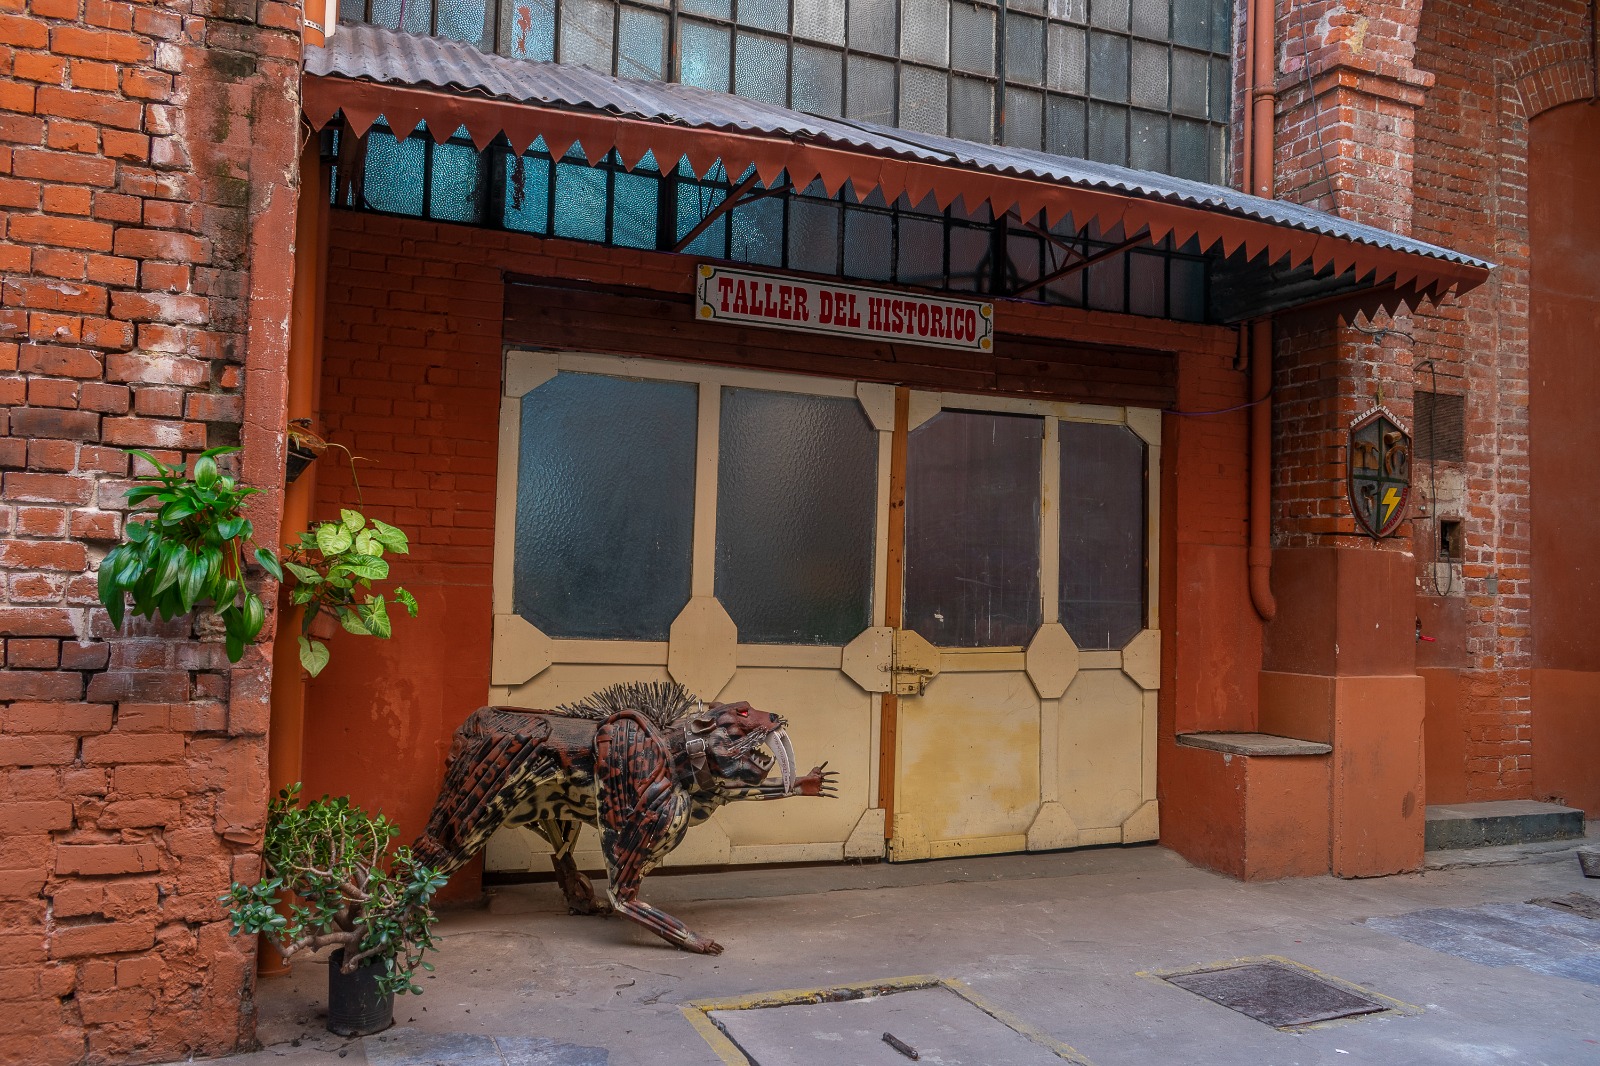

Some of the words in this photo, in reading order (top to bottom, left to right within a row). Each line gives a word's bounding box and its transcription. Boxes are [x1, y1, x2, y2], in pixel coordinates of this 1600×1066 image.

[718, 277, 809, 321] TALLER
[819, 290, 860, 328] DEL
[868, 297, 976, 342] HISTORICO
